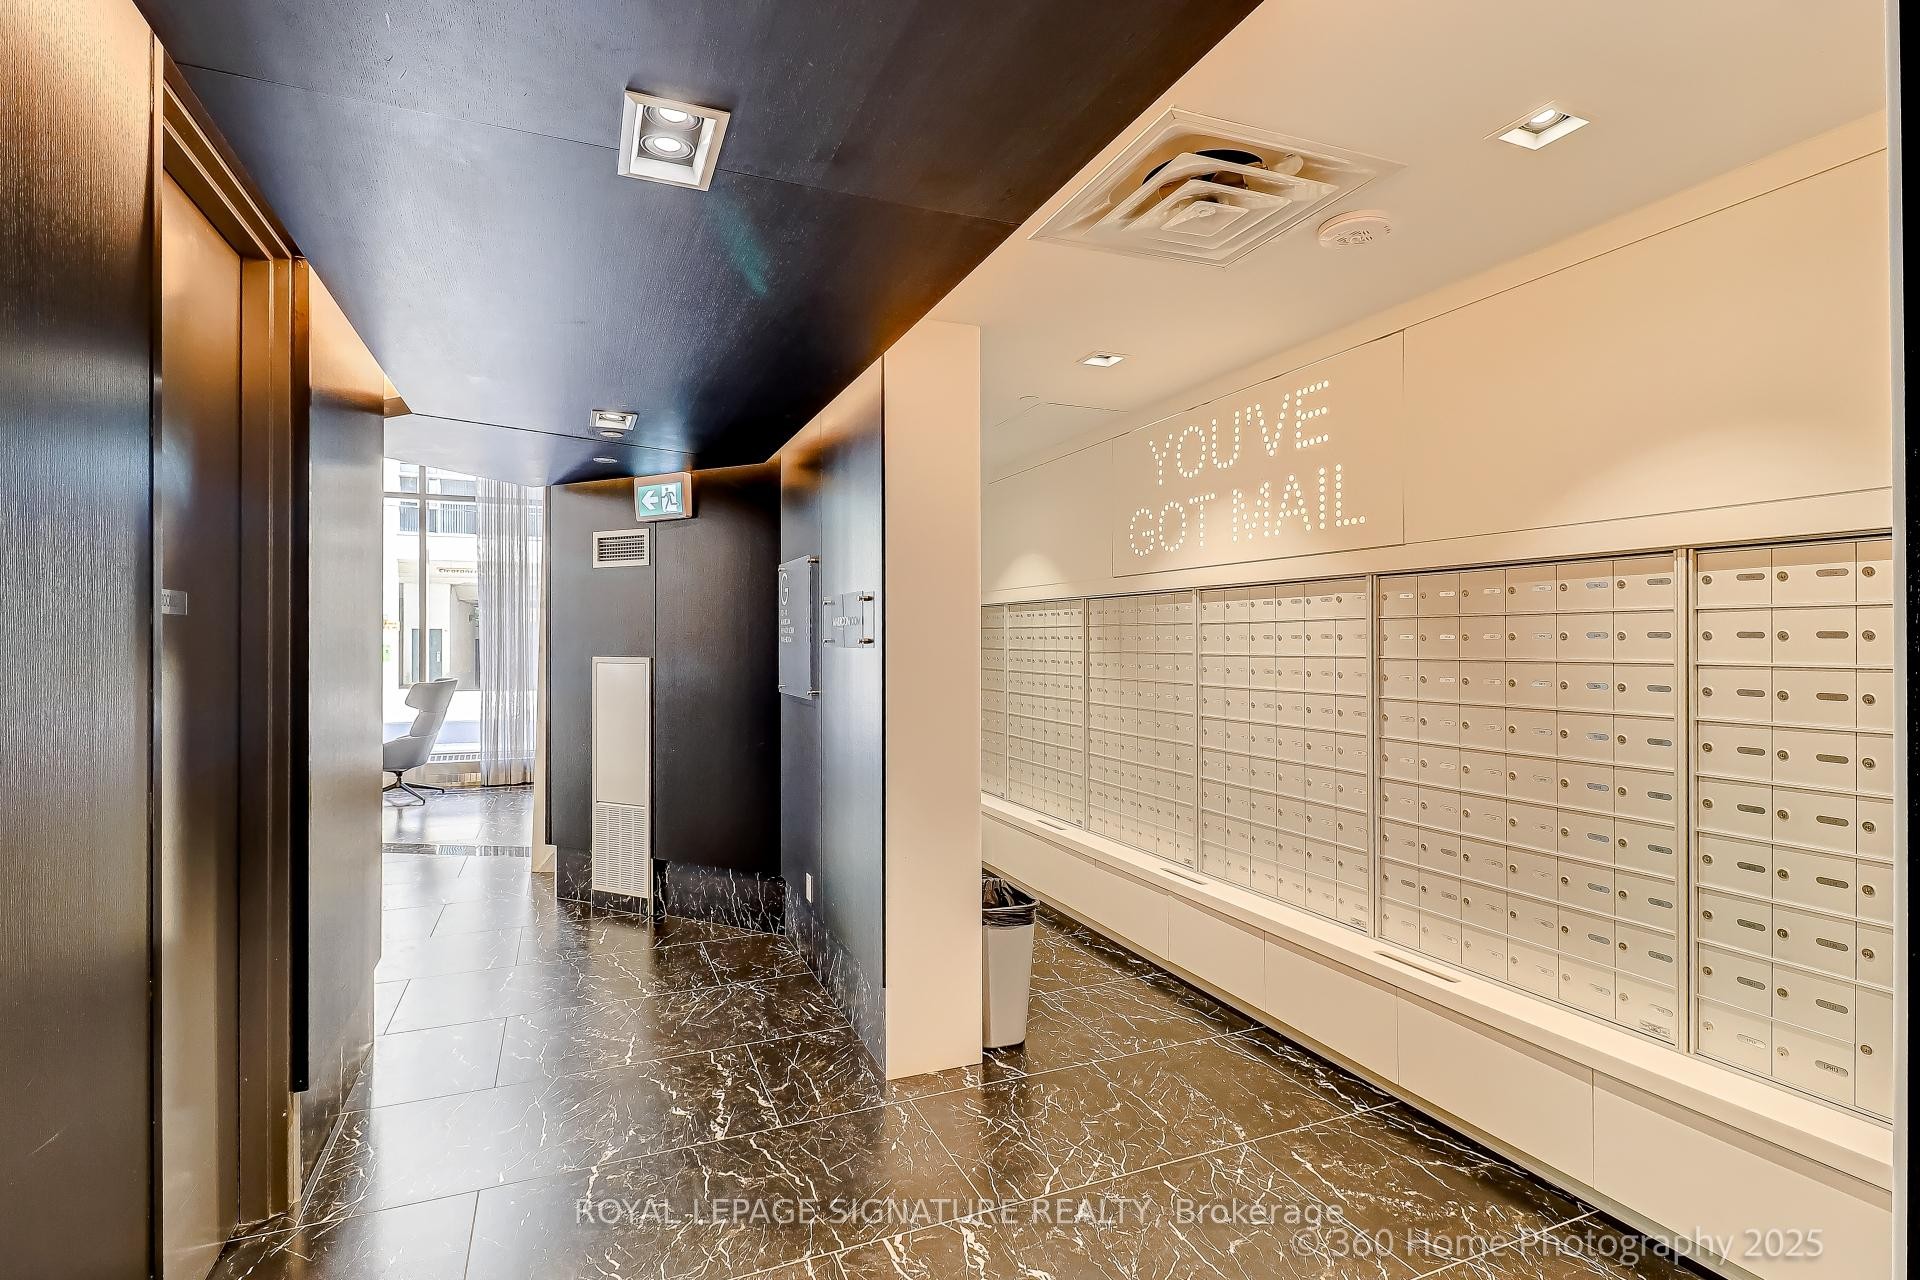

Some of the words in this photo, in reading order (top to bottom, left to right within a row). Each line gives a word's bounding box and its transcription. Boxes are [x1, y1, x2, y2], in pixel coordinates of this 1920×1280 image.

[1148, 379, 1330, 487] YOU'VE
[1128, 491, 1216, 558] GOT
[1231, 463, 1367, 544] MAIL
